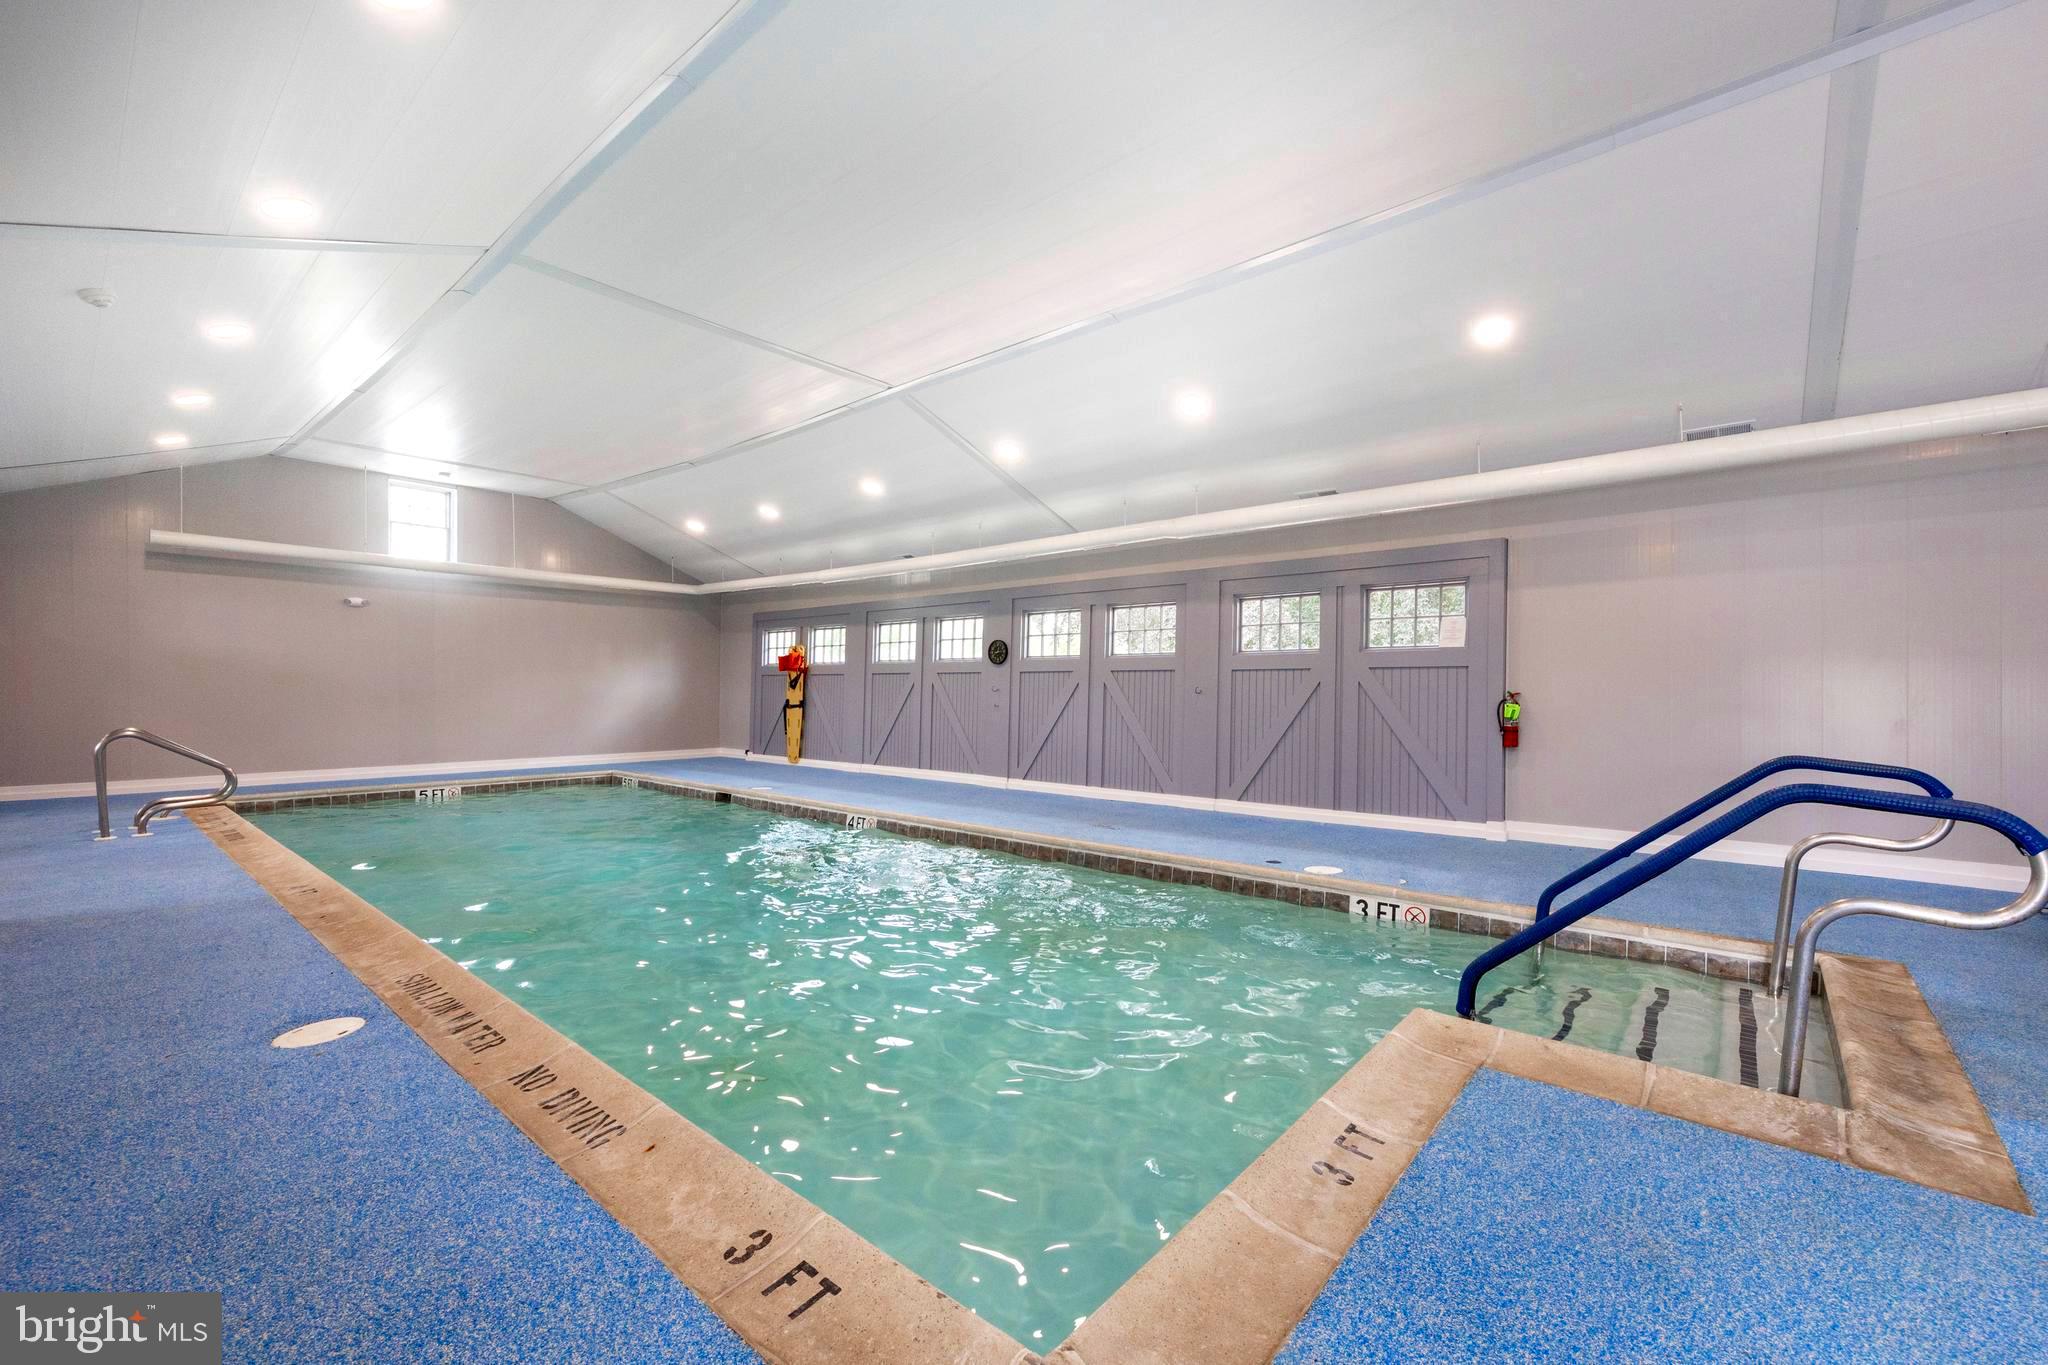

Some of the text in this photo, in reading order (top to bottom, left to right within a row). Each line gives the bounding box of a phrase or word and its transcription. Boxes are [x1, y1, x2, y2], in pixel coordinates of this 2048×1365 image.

[420, 788, 446, 802] 5 FT
[847, 816, 866, 828] 4 FT
[1356, 898, 1401, 922] 3 FT
[507, 1064, 627, 1150] NO DIVING
[1311, 1122, 1386, 1187] 3 FT
[723, 1229, 842, 1321] 3 FT
